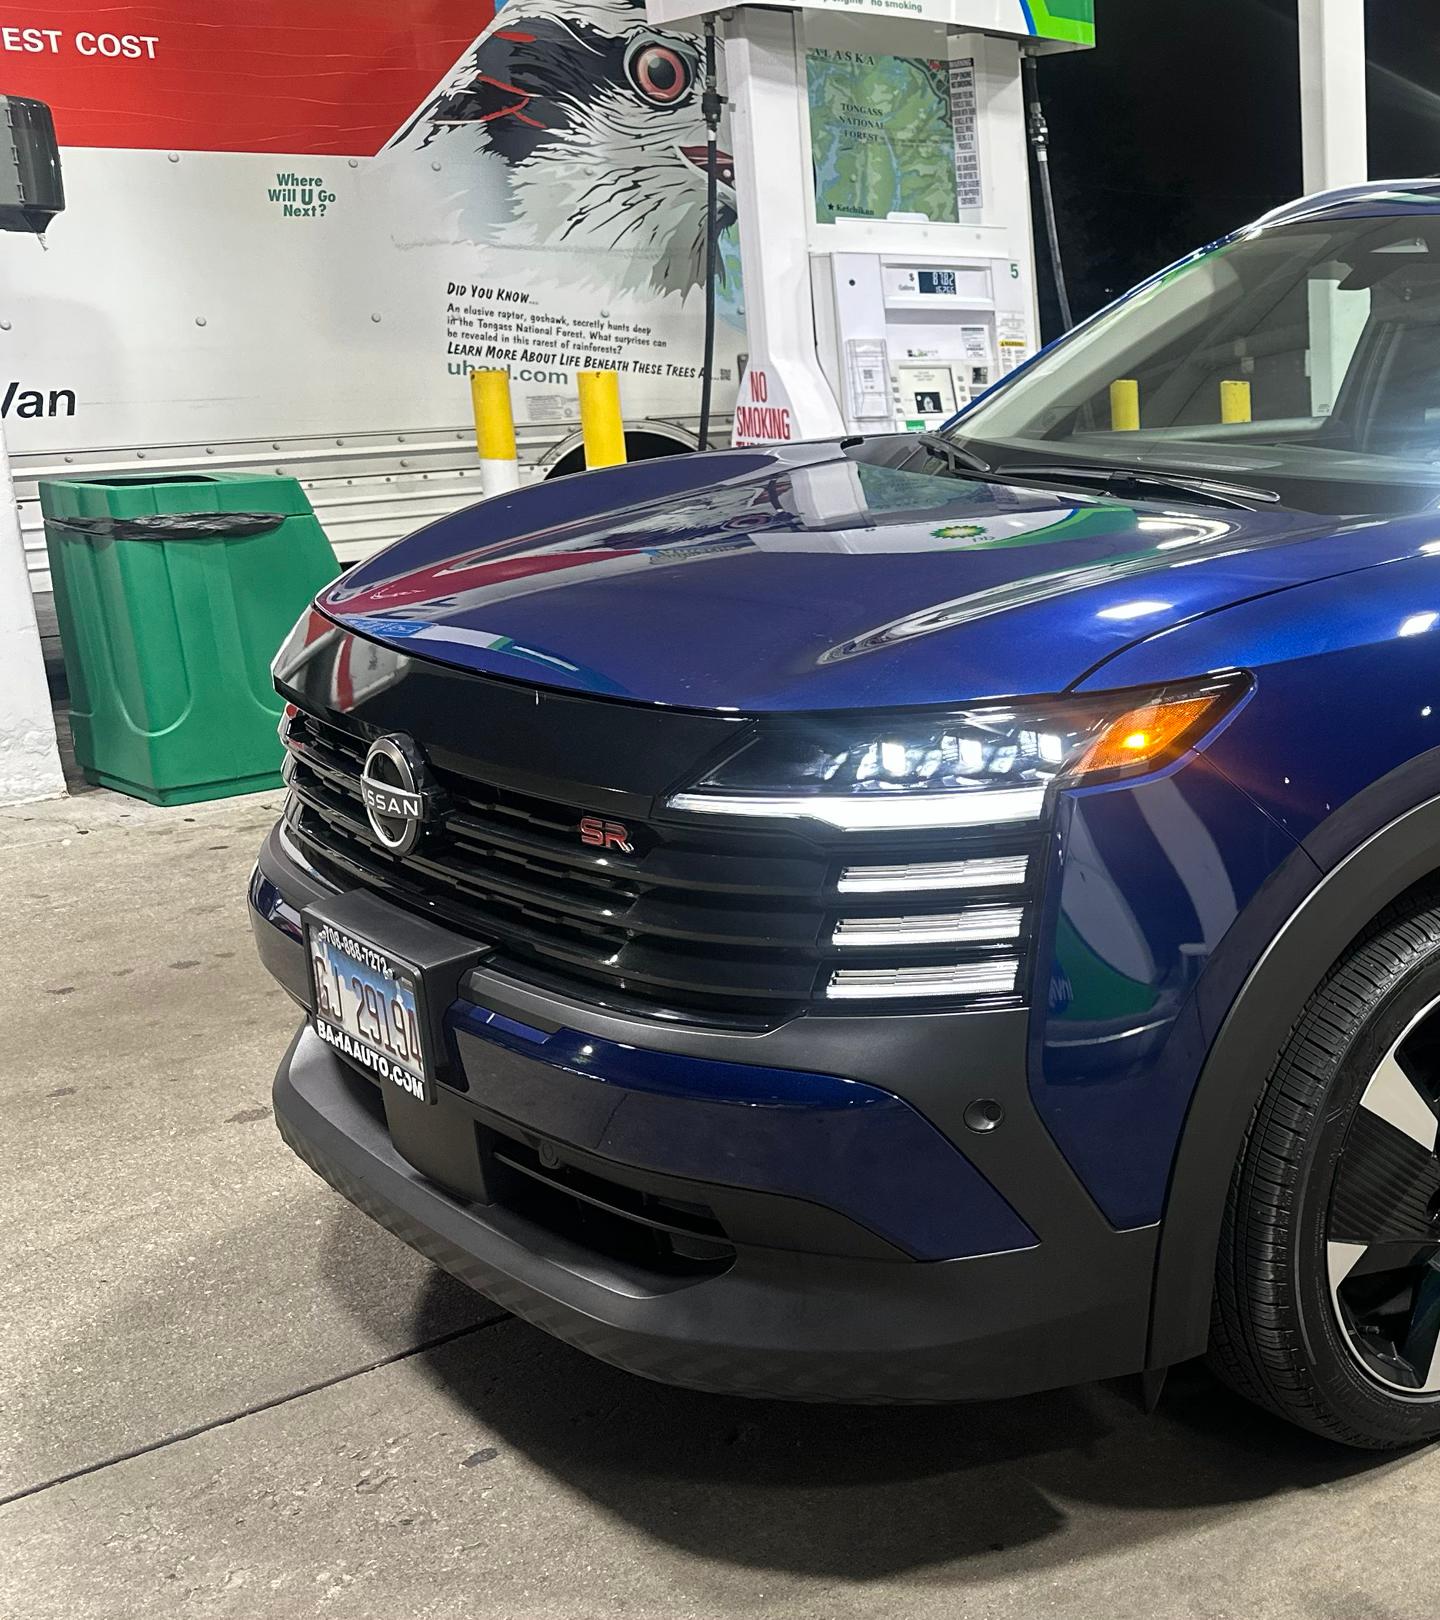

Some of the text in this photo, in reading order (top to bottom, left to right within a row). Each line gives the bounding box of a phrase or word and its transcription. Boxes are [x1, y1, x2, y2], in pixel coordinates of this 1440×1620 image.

[885, 1, 923, 13] smoking
[75, 31, 160, 59] COST
[812, 48, 875, 65] ALASKA
[841, 103, 883, 116] TONGASS
[839, 116, 885, 129] NATIONAL
[844, 130, 879, 141] FOREST
[276, 173, 323, 187] Where
[267, 188, 337, 206] Will U Go
[282, 204, 327, 217] Next?
[836, 204, 875, 216] Ketchikan
[1010, 263, 1019, 279] 5
[446, 303, 651, 336] An elusive raptor, goshawk, secretly hunts deep
[447, 316, 667, 348] in the Tongass National Forest. What surprises can
[447, 328, 623, 354] be revealed in this rarest of rainforests?
[447, 360, 569, 385] uhl.com
[750, 371, 768, 403] NO
[736, 406, 791, 440] SMOKING
[363, 787, 419, 816] SSAN
[579, 816, 634, 853] SR
[322, 924, 387, 973] 708-888-7272
[352, 976, 423, 1072] 29194
[316, 1019, 424, 1102] BAHAAUTO.COM
